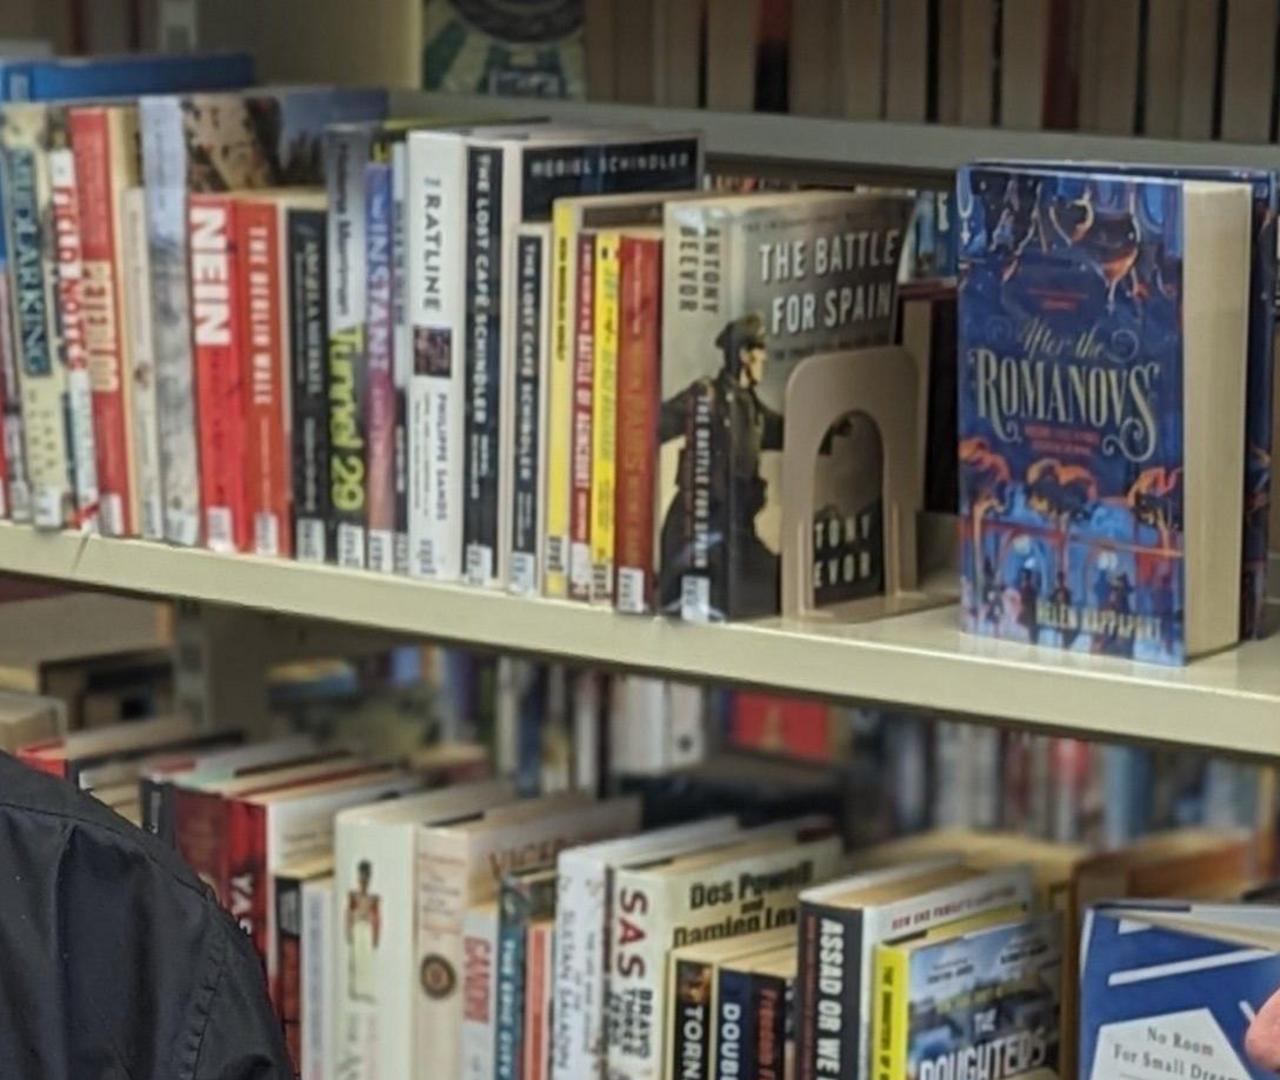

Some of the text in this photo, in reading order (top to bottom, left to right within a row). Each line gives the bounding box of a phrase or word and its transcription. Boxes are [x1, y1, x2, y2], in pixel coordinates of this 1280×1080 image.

[597, 150, 690, 174] SCHINDLER
[191, 206, 232, 345] NEIN
[424, 194, 442, 312] RATLINE
[679, 227, 699, 312] BEEVOR
[703, 227, 720, 312] ANTONY
[759, 229, 900, 282] THE BATTLE
[473, 154, 492, 423] THE LOST SCHINDLER
[772, 282, 893, 335] FOR SPAIN
[329, 325, 365, 511] Tunnel 29
[969, 347, 1161, 463] ROMANOVS
[690, 860, 814, 911] Des Powell
[502, 939, 515, 964] THE
[616, 887, 649, 980] SAS
[672, 911, 761, 949] Damien
[819, 918, 844, 996] ASSAD
[621, 987, 636, 1055] THREE
[638, 990, 654, 1058] BRAVO
[757, 989, 778, 1065] Freedom
[817, 999, 843, 1033] OR
[974, 1009, 997, 1033] THE
[1147, 1026, 1213, 1057] No Room
[816, 1038, 841, 1074] WE
[1113, 1044, 1137, 1064] For
[1143, 1050, 1185, 1077] Small
